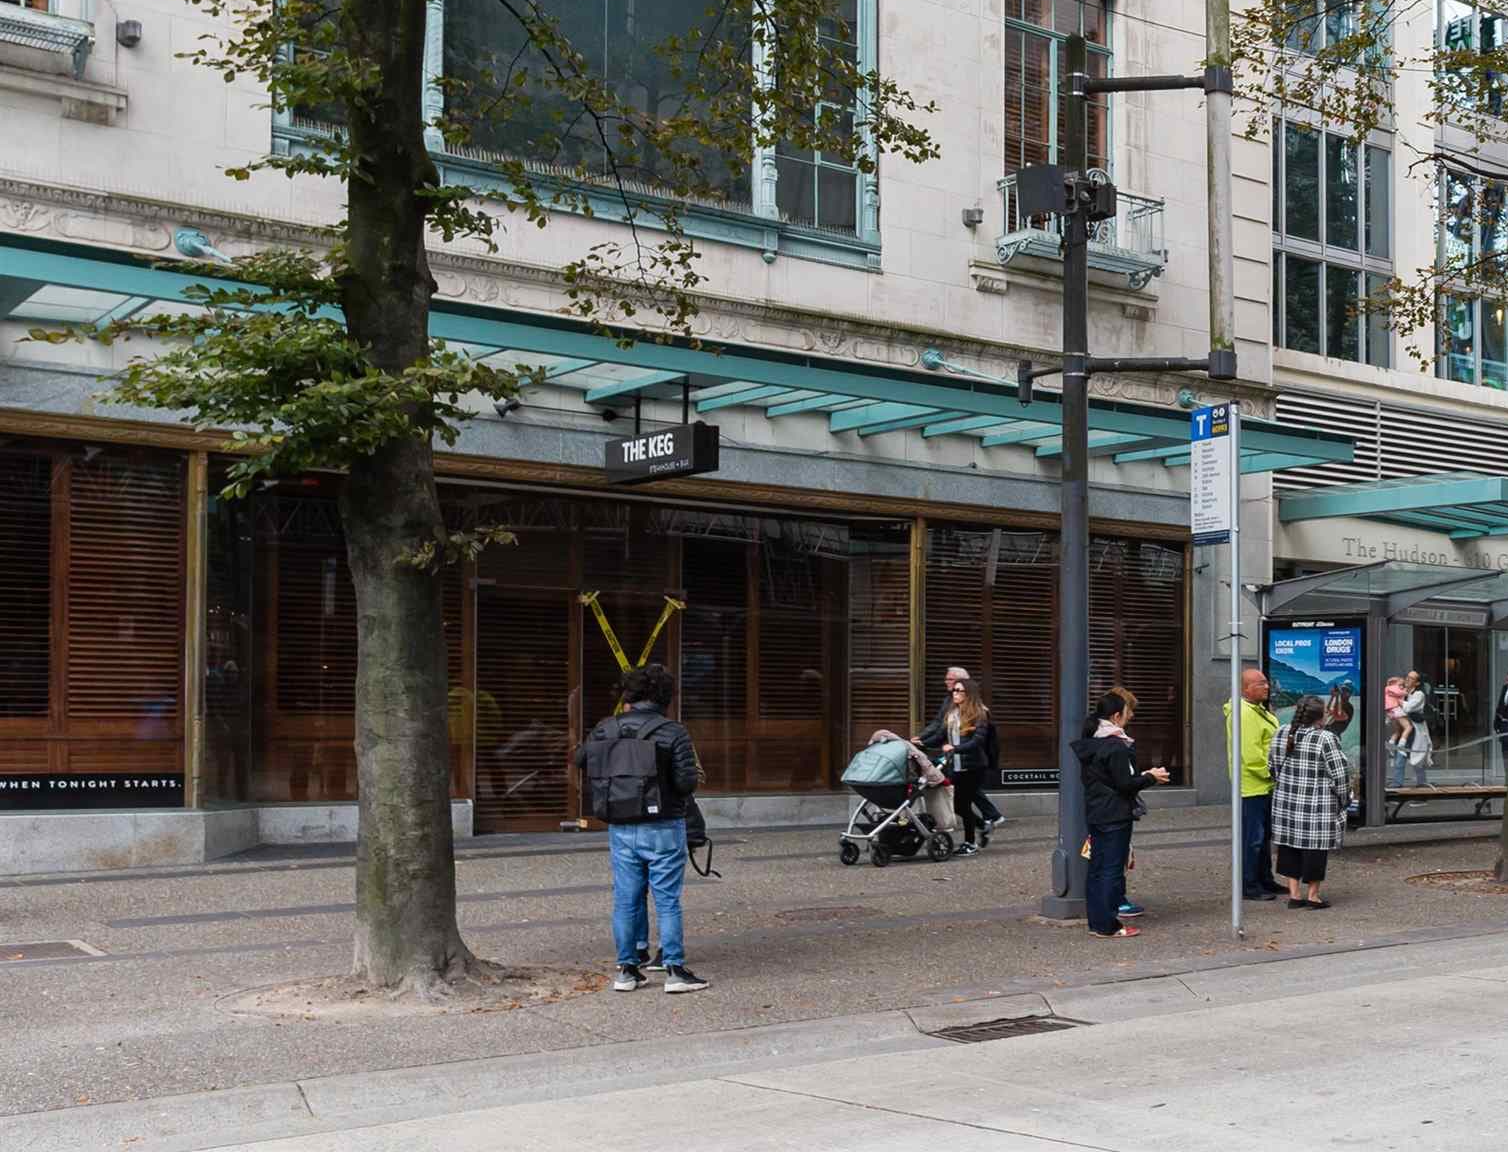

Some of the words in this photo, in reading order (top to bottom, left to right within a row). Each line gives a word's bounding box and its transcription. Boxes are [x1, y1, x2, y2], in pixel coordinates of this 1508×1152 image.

[1196, 414, 1207, 436] T
[622, 438, 647, 463] THE
[648, 432, 674, 458] KEG
[1342, 537, 1377, 559] The
[1382, 541, 1448, 565] Hudson
[49, 780, 116, 788] TONIGHT
[124, 779, 182, 788] STARTS.
